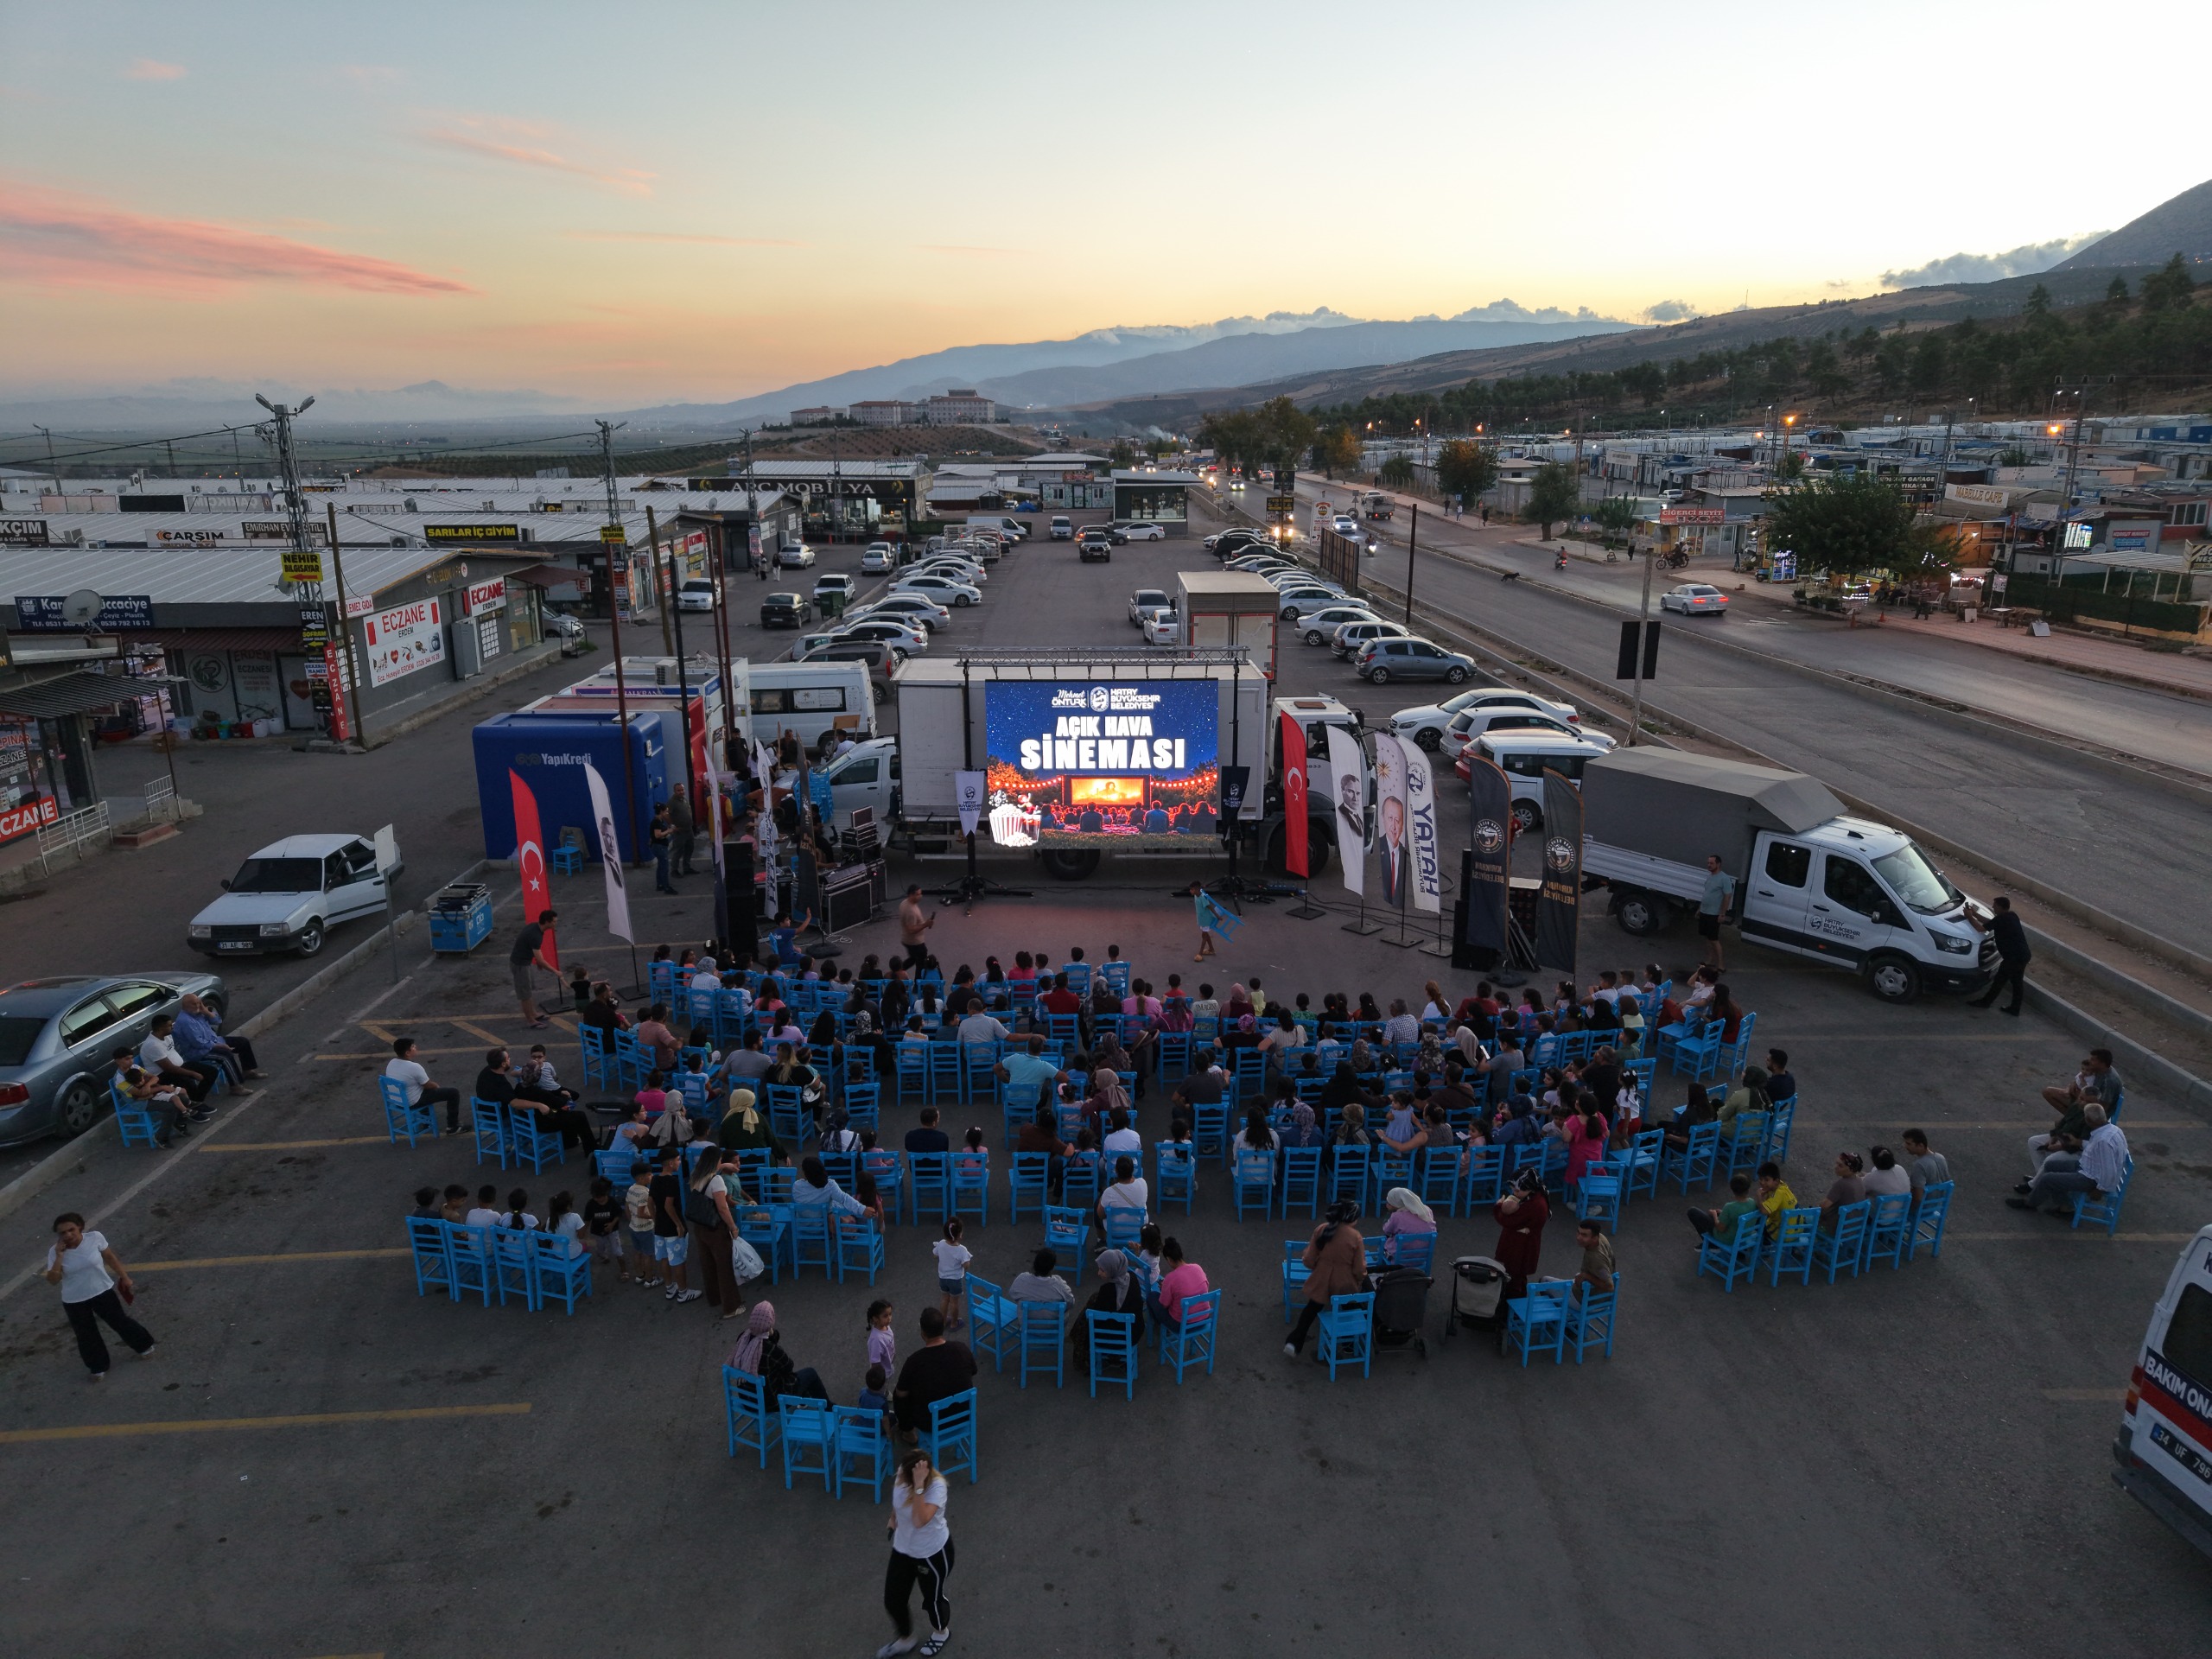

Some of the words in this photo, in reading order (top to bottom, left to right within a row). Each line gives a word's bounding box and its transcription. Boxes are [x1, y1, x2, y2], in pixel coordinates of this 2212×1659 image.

[427, 528, 472, 537] SARILAR
[471, 581, 505, 606] ECZANE
[301, 611, 324, 620] EREN
[382, 604, 426, 633] ECZANE
[1055, 715, 1101, 740] AÇIK
[1104, 715, 1154, 737] HAVA
[541, 753, 593, 766] YapıKredi
[1020, 733, 1185, 770] SİNEMASI
[0, 800, 54, 836] CZANE
[2146, 1354, 2189, 1401] BAKIM
[2158, 1430, 2170, 1446] 34
